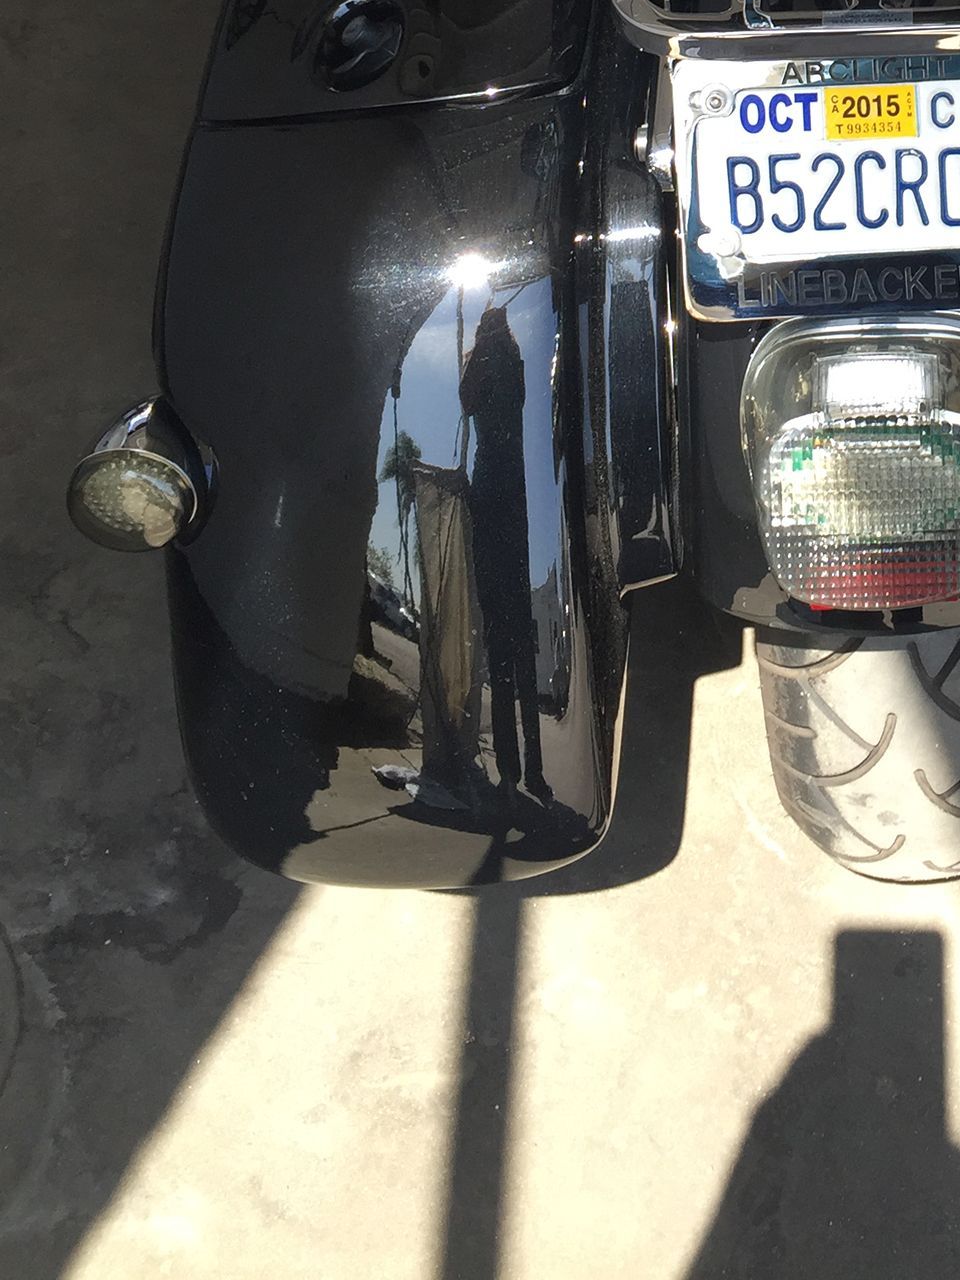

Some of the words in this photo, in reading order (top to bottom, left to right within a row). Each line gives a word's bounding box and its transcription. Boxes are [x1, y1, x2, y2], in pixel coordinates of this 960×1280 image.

[781, 56, 952, 85] ARCLIGHT
[739, 93, 818, 134] OCT
[842, 94, 900, 119] 2015
